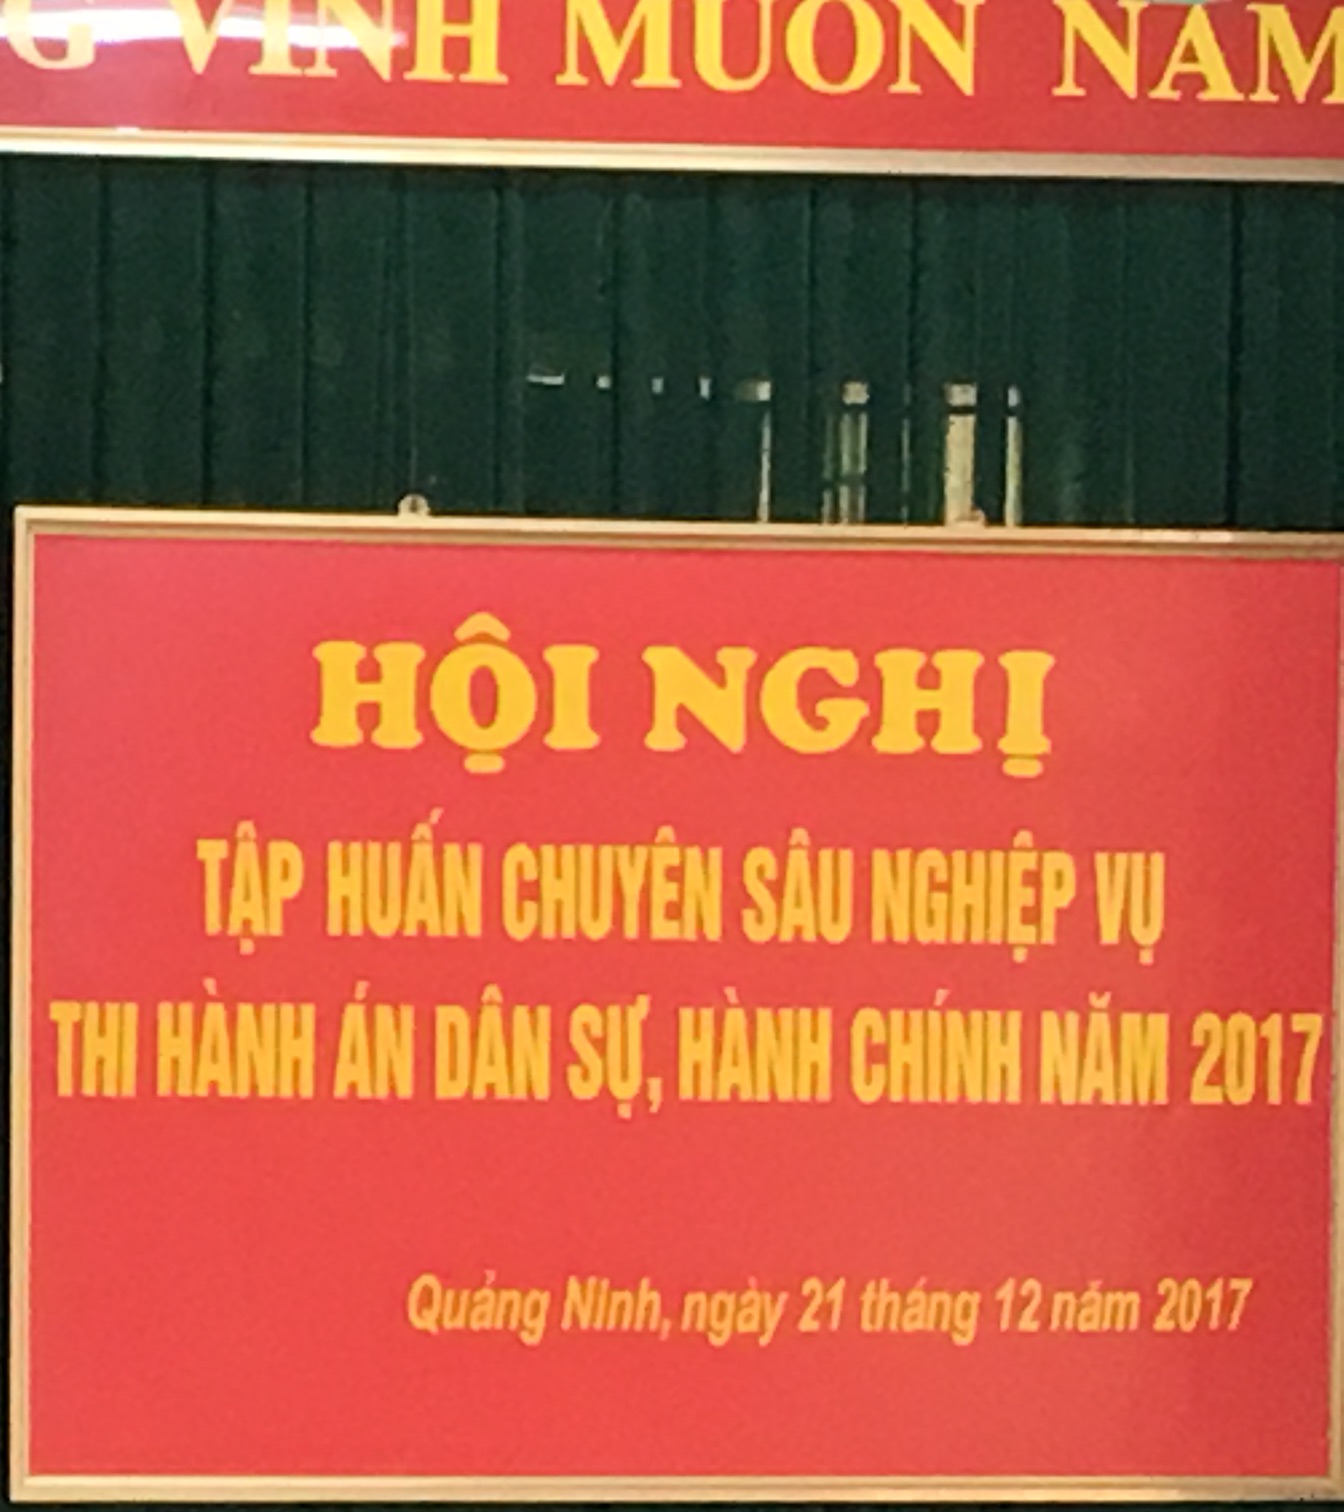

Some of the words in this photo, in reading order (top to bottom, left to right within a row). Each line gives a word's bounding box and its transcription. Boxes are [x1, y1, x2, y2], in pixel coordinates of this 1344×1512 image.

[170, 0, 509, 83] VINH
[310, 611, 600, 774] HỘI
[642, 646, 1056, 778] NGHỊ
[196, 820, 305, 955] TẬP
[327, 807, 483, 938] HUẤN
[502, 824, 723, 942] CHUYÊN
[742, 827, 854, 944] SÂU
[871, 829, 1077, 963] NGHIỆP
[1094, 851, 1165, 965] VỤ
[49, 1000, 139, 1097] THI
[157, 977, 316, 1099] HÀNH
[333, 980, 415, 1099] ÁN
[435, 984, 551, 1101] DÂN
[567, 994, 662, 1119] SỰ,
[678, 986, 833, 1102] HÀNH
[850, 988, 1023, 1104] CHÍNH
[1039, 991, 1169, 1106] NĂM
[1190, 1011, 1323, 1106] 2017
[408, 1270, 551, 1346] Quảng
[561, 1275, 672, 1340] Ninh,
[681, 1277, 789, 1347] ngày
[798, 1277, 847, 1333] 21
[860, 1277, 981, 1346] tháng
[995, 1277, 1043, 1333] 12
[1050, 1279, 1141, 1333] năm
[1153, 1278, 1253, 1333] 2017
